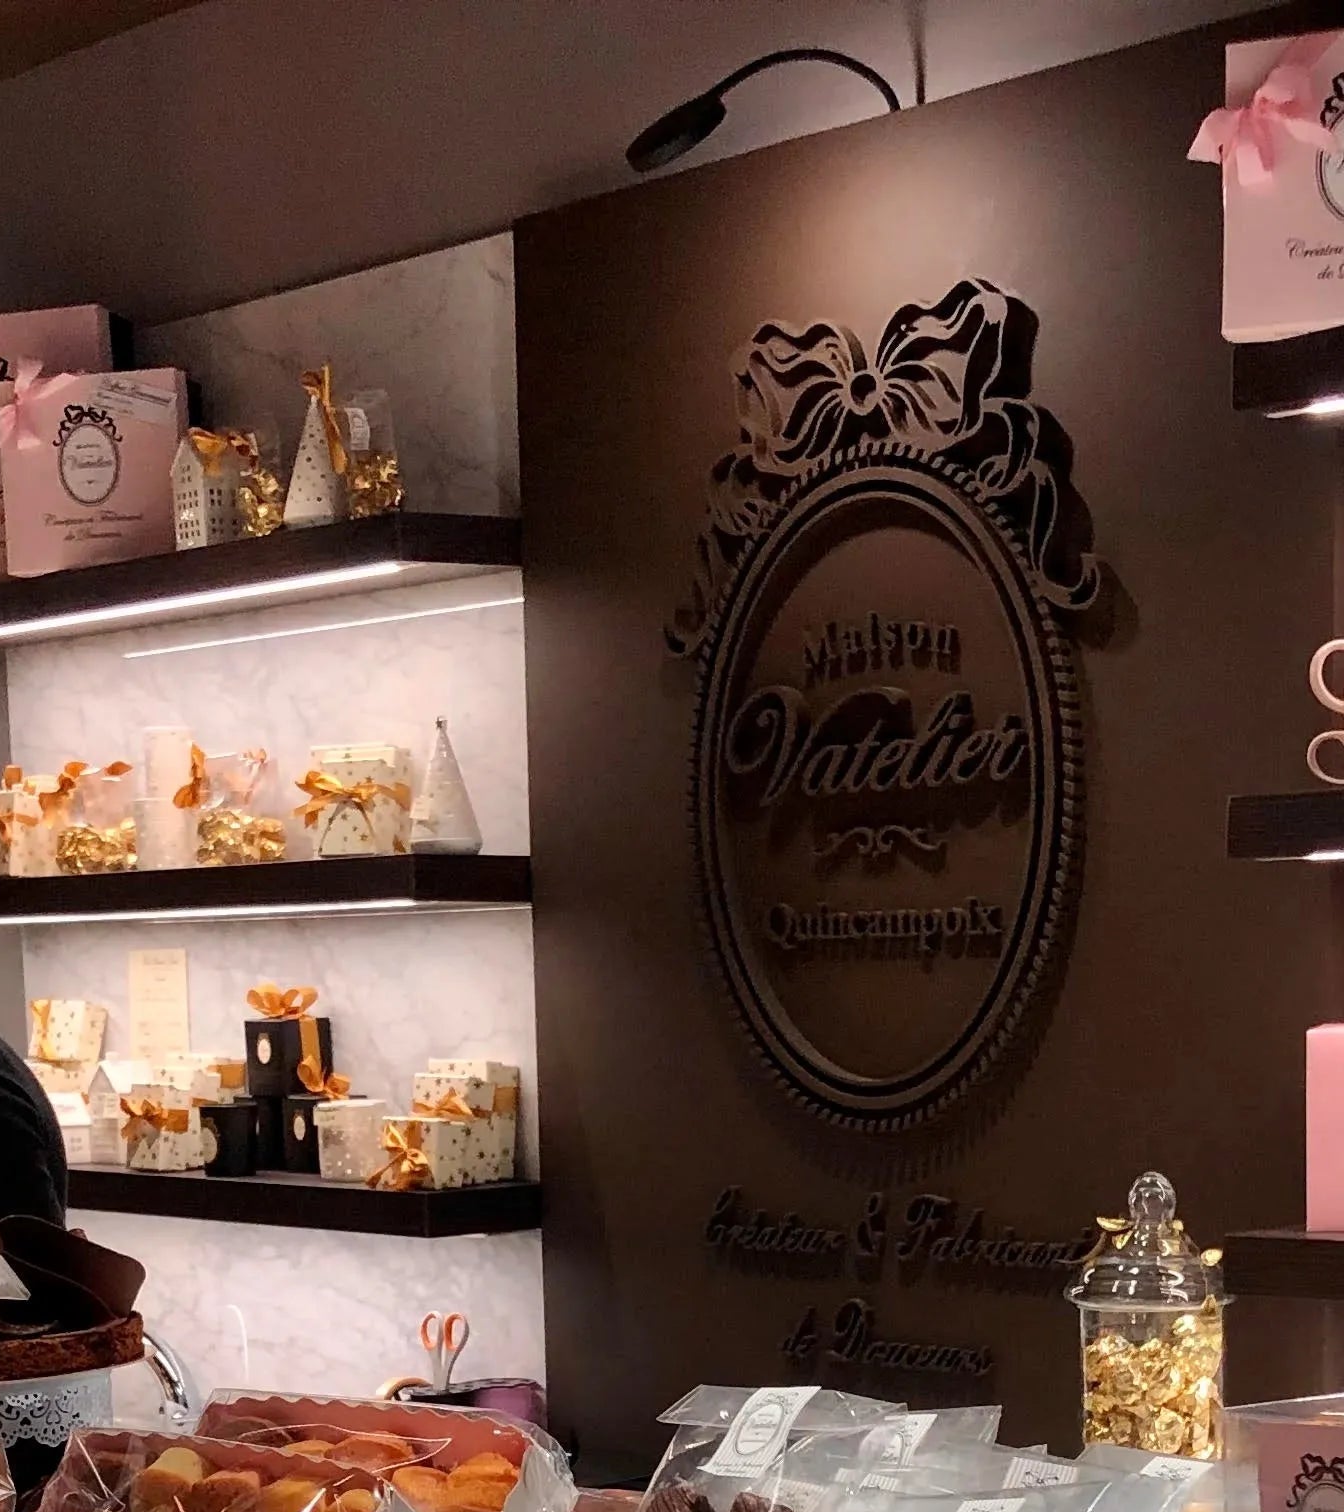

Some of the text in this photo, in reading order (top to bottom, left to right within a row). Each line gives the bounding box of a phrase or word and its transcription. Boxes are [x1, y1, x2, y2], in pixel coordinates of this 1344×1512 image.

[1317, 266, 1334, 280] de
[806, 611, 960, 666] Maison
[726, 685, 1030, 806] Vatelier
[765, 897, 1005, 950] Quincampoix
[703, 1184, 848, 1254] Créateur
[855, 1191, 886, 1257] &
[780, 1297, 1000, 1377] de Douceurs
